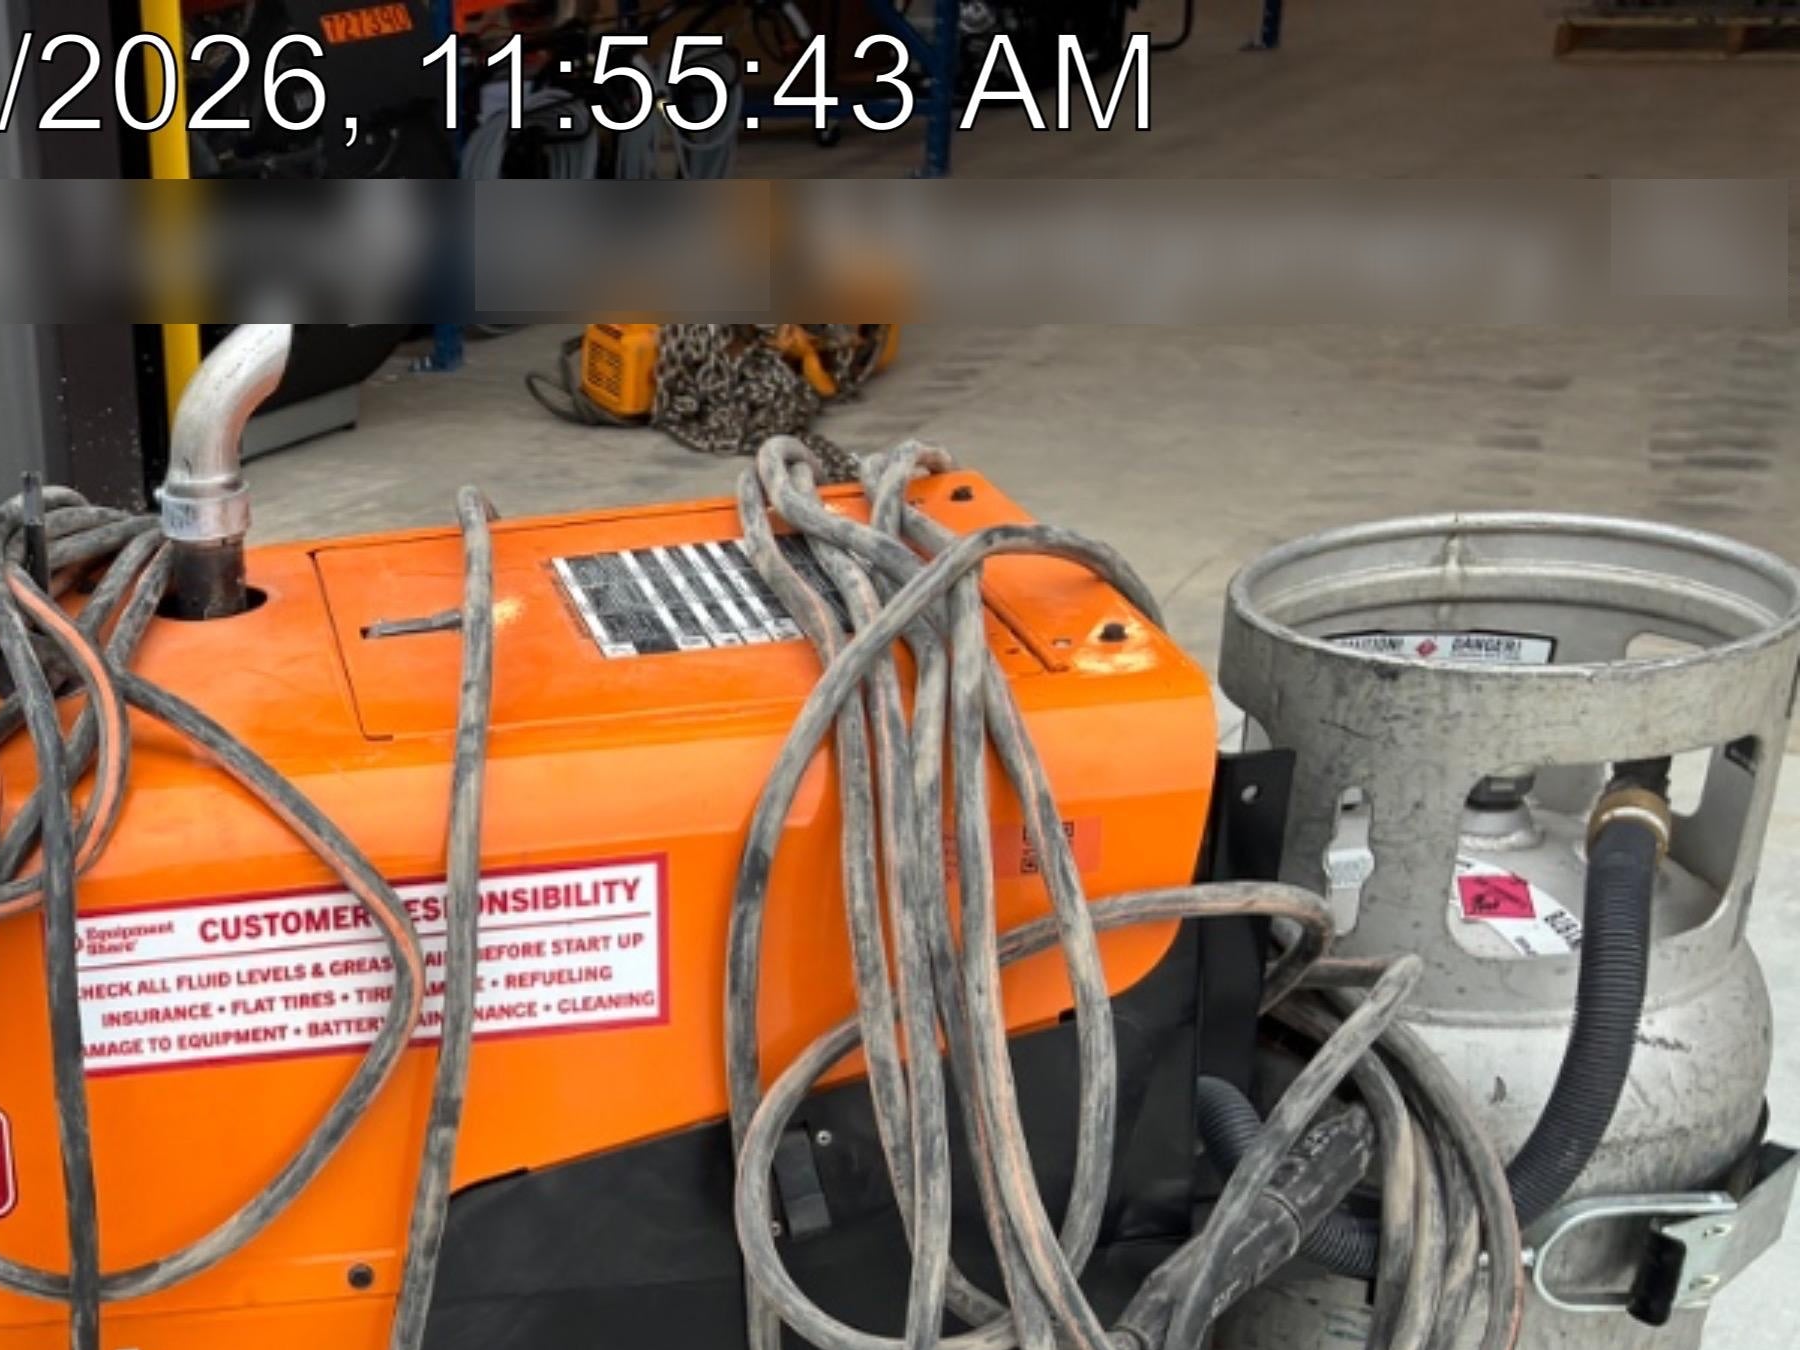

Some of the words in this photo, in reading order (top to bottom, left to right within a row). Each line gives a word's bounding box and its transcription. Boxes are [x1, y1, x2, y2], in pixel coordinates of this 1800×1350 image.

[199, 903, 373, 943] CUSTOMER
[404, 876, 641, 923] ESNSIBILITY
[79, 980, 132, 1001] HECK
[137, 976, 171, 995] ALL
[176, 971, 231, 992] FLUID
[236, 963, 307, 986] LEVELS
[311, 961, 325, 978] &
[329, 956, 394, 978] GREAS
[551, 936, 611, 956] START
[617, 932, 644, 949] UP
[101, 1003, 211, 1028] INSURANCE
[231, 996, 275, 1016] FLAT
[281, 989, 336, 1010] TIRES
[504, 965, 613, 989] REFUELING
[82, 1038, 143, 1058] AMAGE
[149, 1036, 171, 1052] TO
[176, 1025, 288, 1050] EQUIPMENT
[416, 1004, 538, 1027] AINNANCE
[556, 990, 655, 1015] CLEANING
